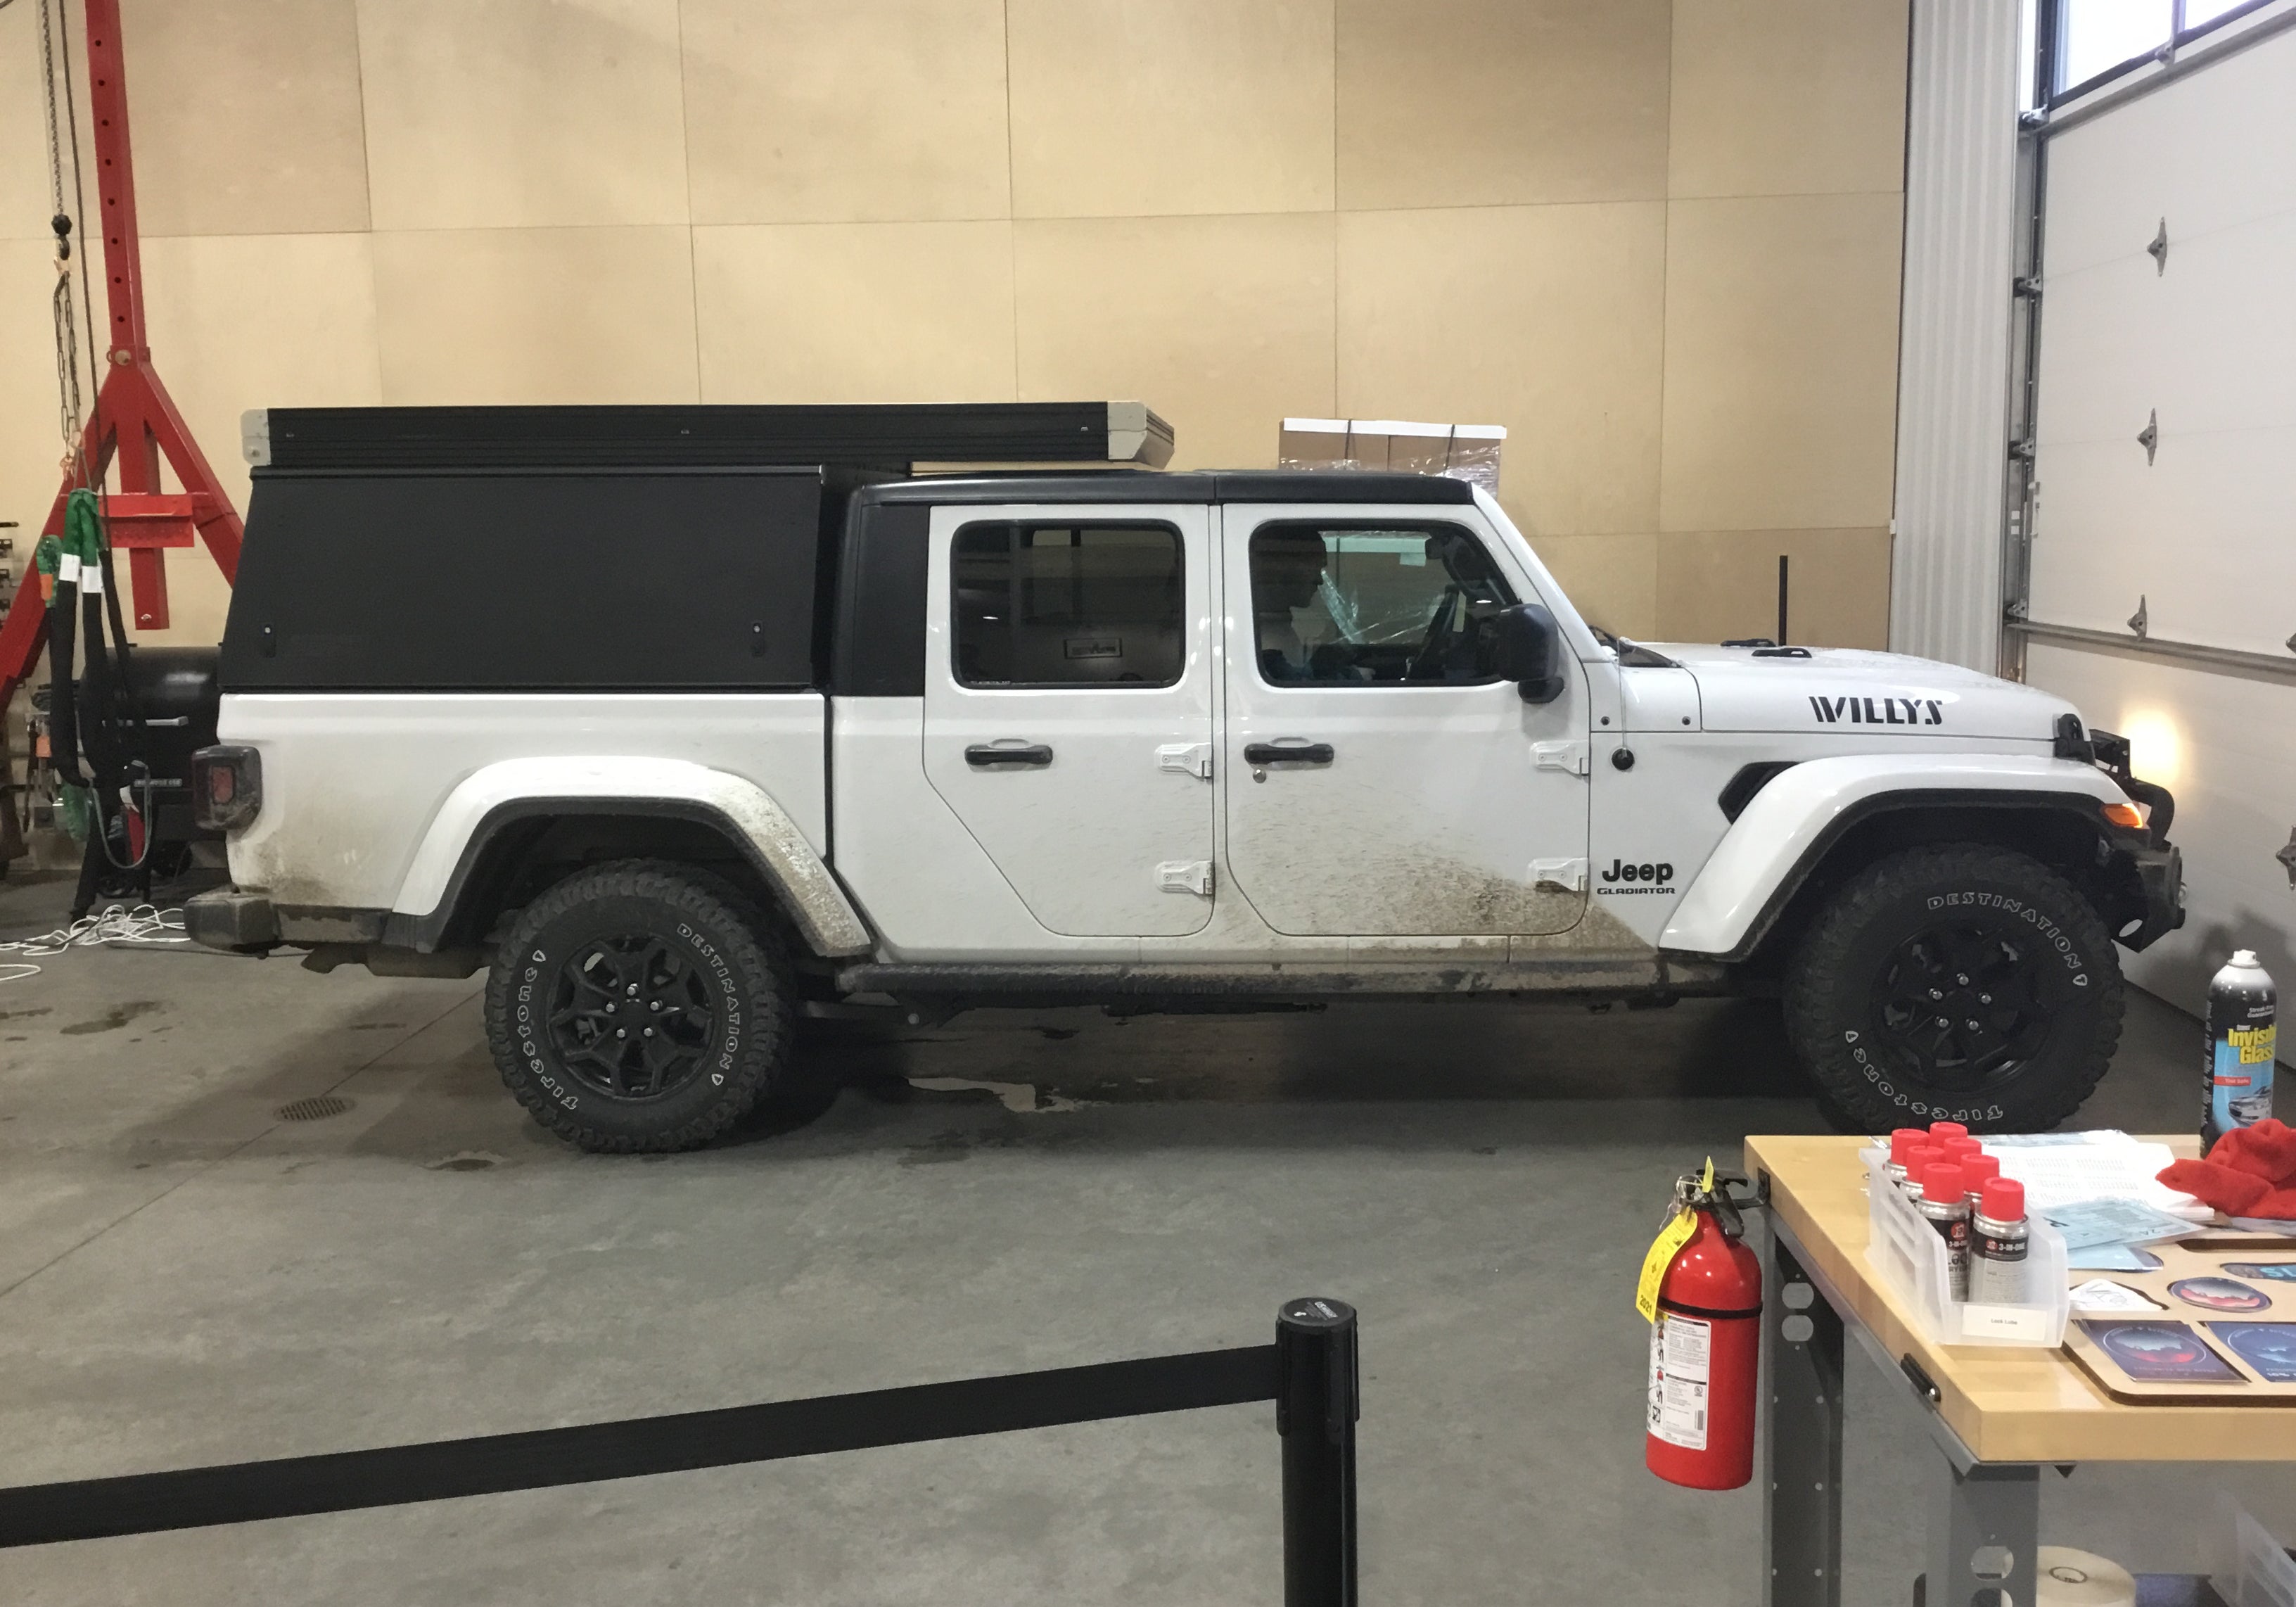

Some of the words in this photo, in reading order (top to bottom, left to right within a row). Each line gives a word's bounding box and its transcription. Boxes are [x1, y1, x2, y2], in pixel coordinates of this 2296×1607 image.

[1809, 696, 1943, 725] WILLYS
[1602, 858, 1673, 885] Jeep
[1927, 891, 2082, 969] DESTINATION
[677, 923, 740, 1070] DESTINATION
[1640, 1294, 1652, 1316] 2021
